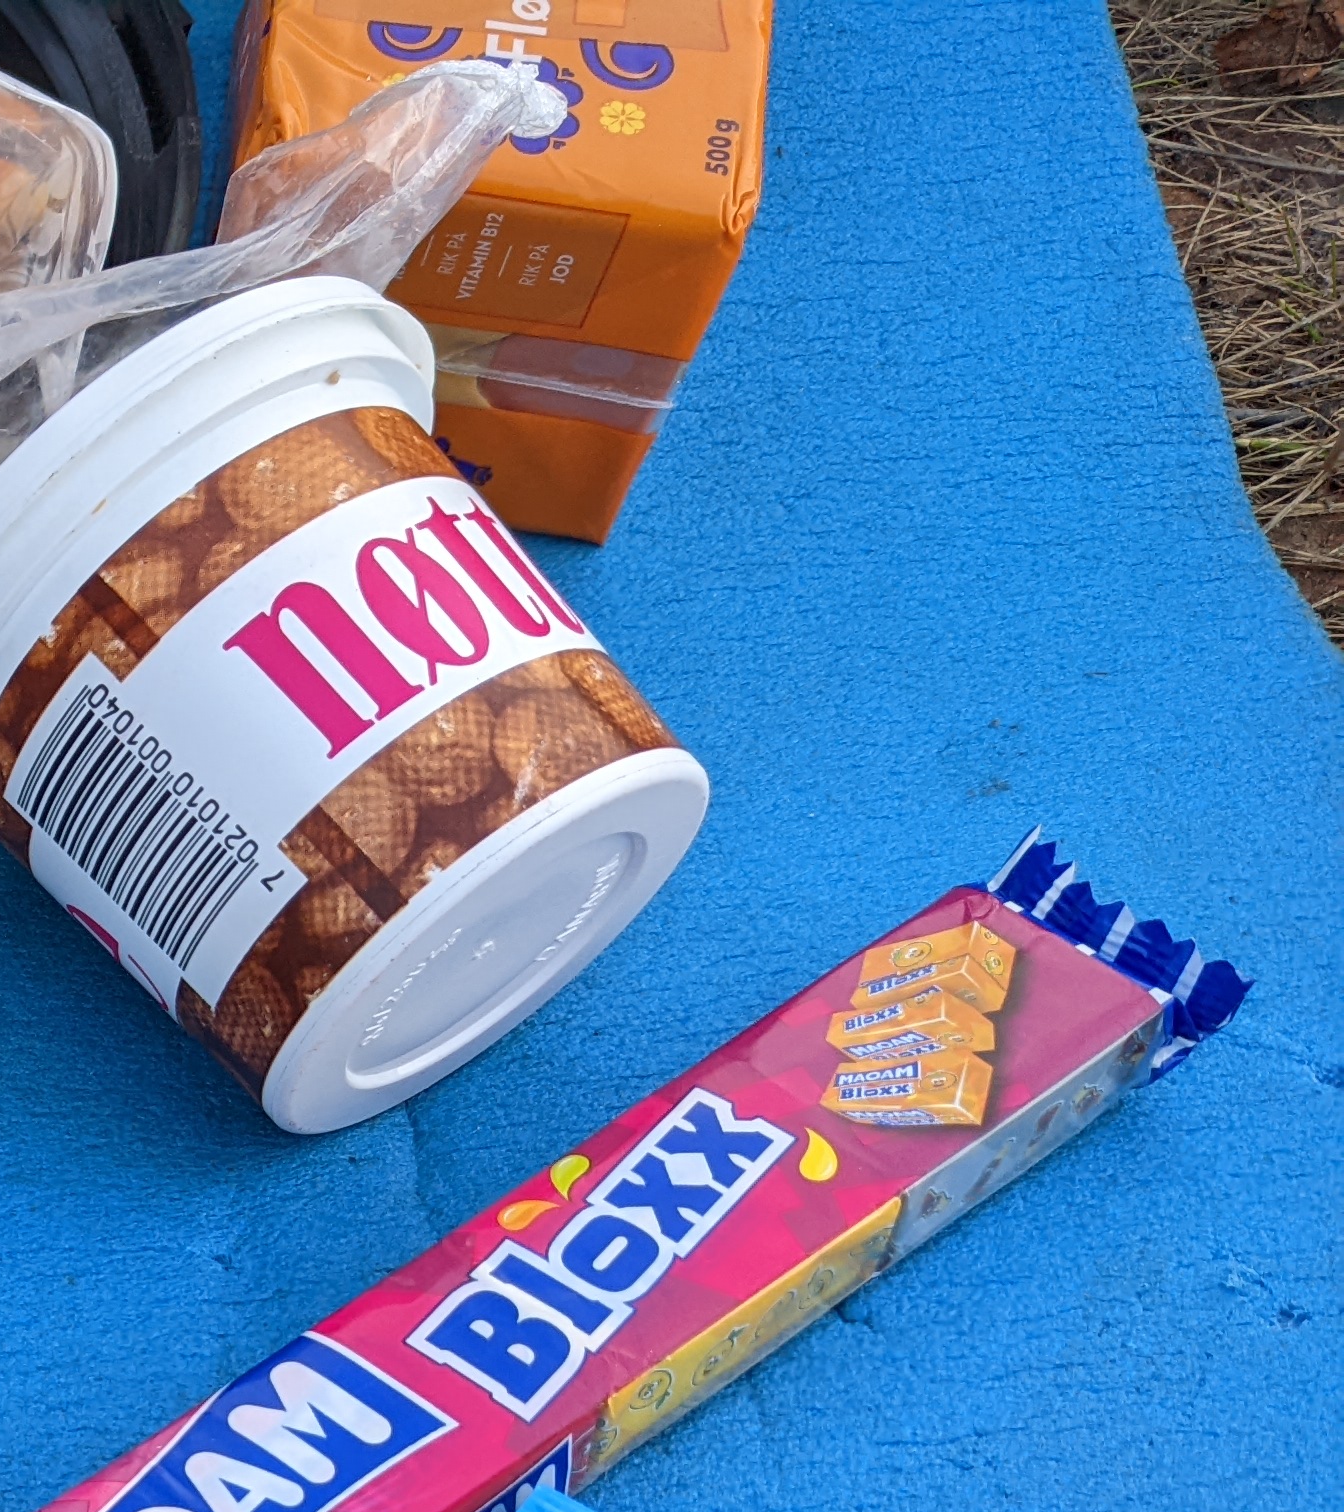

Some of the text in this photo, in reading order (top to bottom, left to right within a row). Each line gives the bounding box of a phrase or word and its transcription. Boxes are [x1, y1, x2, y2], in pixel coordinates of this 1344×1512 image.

[705, 117, 740, 176] 500 g
[436, 231, 467, 275] RIK PÅ
[456, 212, 505, 299] VITAMIN B12
[519, 243, 551, 287] RIK PÅ
[549, 254, 576, 285] JOD
[87, 682, 285, 894] 7 021010 001040
[844, 1003, 903, 1033] Bloxx
[838, 1064, 915, 1087] MAOAM
[839, 1083, 914, 1101] Bloxx
[417, 1095, 787, 1412] Bloxx
